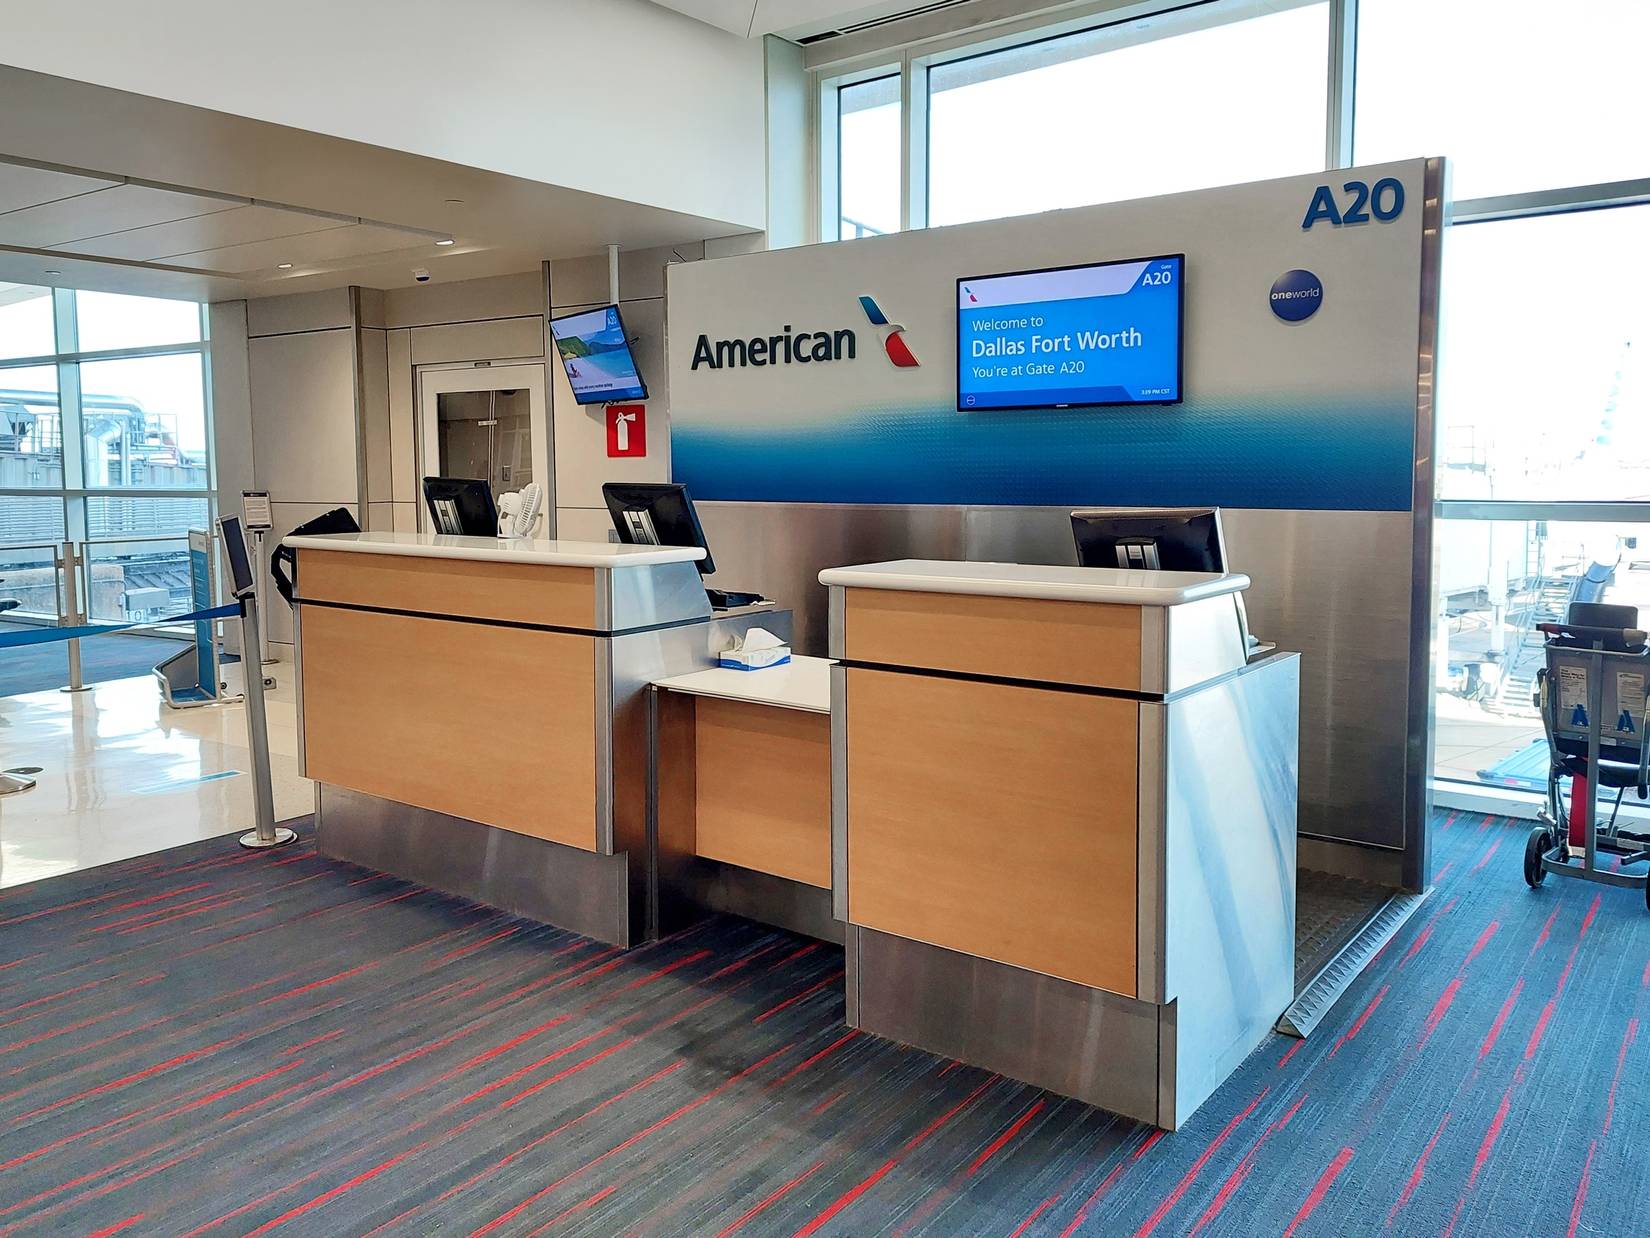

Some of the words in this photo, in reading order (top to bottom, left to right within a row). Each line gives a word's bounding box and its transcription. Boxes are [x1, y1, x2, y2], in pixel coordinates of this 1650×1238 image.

[1302, 178, 1405, 228] A20
[1142, 271, 1172, 286] A20
[1271, 288, 1320, 300] oneworld
[972, 318, 1028, 332] Welcome
[1031, 316, 1044, 327] to
[691, 325, 856, 370] American
[972, 337, 1025, 357] Dallas
[1031, 335, 1071, 353] Fort
[1077, 327, 1142, 350] Worth
[972, 366, 1008, 378] You're
[1011, 366, 1023, 376] at
[1026, 363, 1055, 375] Gate
[1060, 361, 1085, 374] A20
